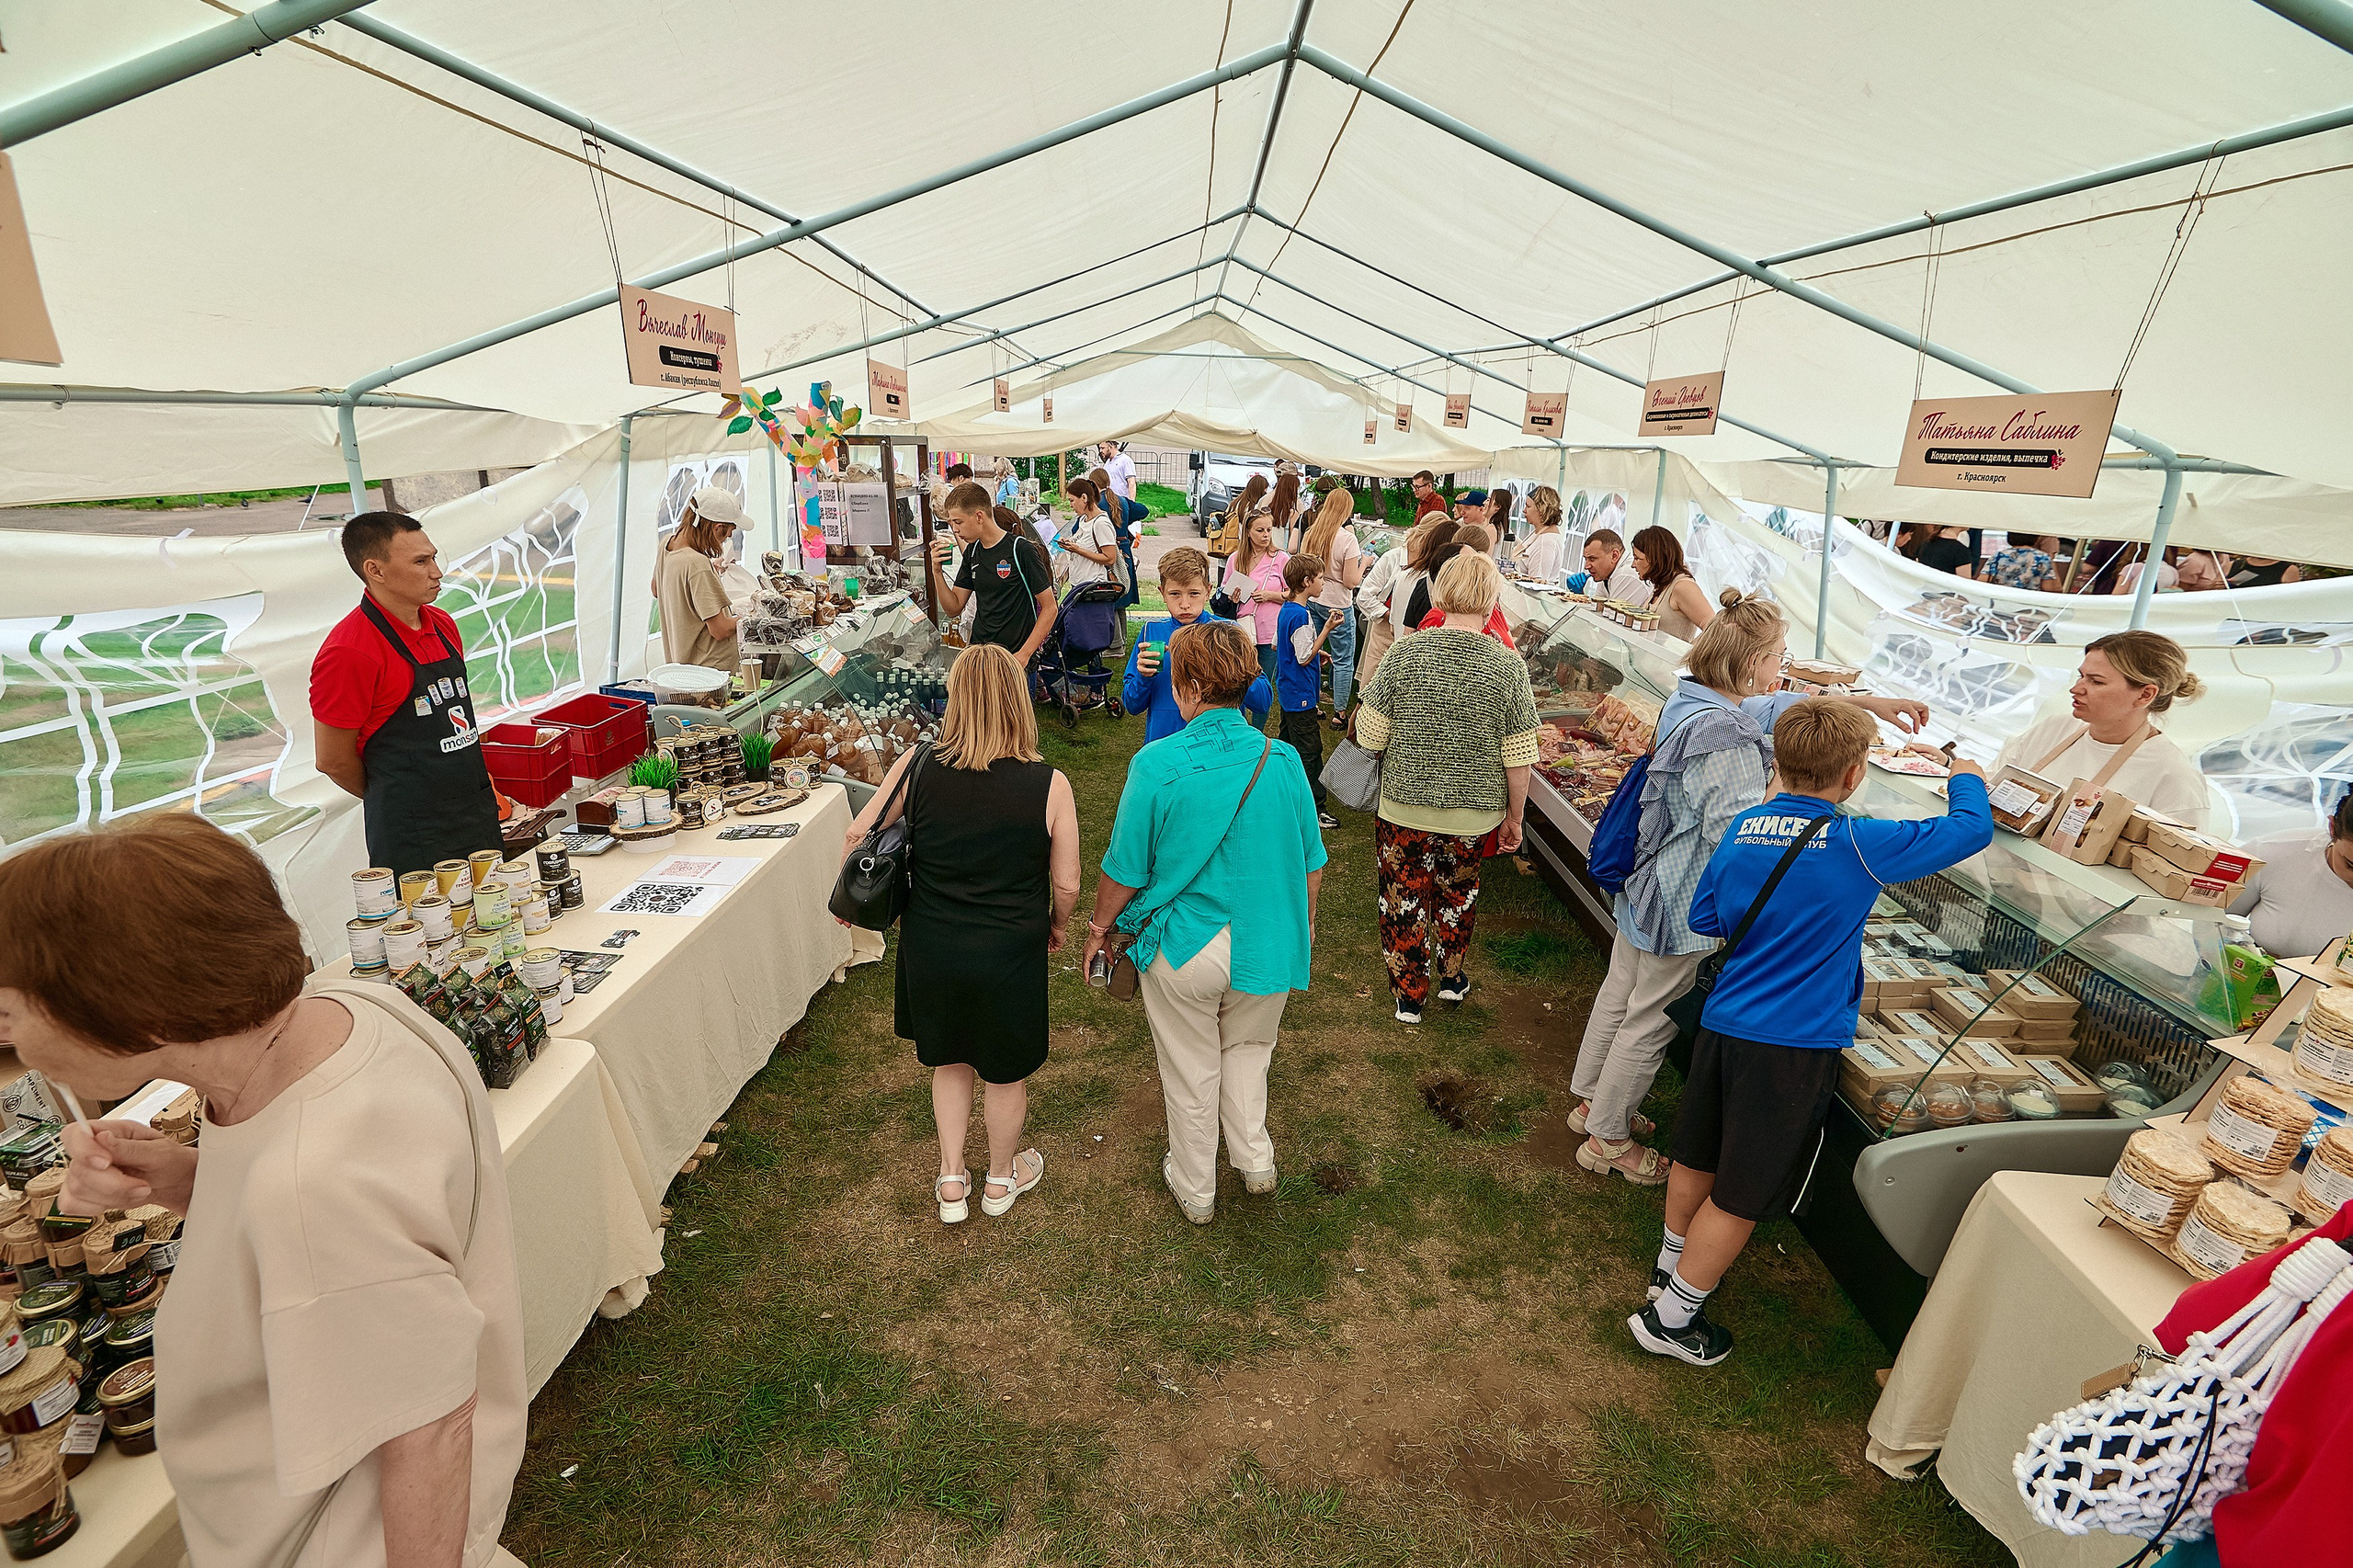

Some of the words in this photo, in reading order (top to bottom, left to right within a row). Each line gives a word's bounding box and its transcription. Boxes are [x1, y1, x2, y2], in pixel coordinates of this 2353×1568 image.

[1917, 412, 1998, 440] Татьяна
[2000, 409, 2084, 442] Саблина
[1930, 450, 1979, 462] Кондитерские
[1980, 453, 2013, 463] изделия,
[2013, 454, 2049, 464] выпечка
[1957, 472, 1963, 481] г.
[1963, 472, 2006, 484] Красноярск
[1802, 840, 1827, 849] ЛУБ
